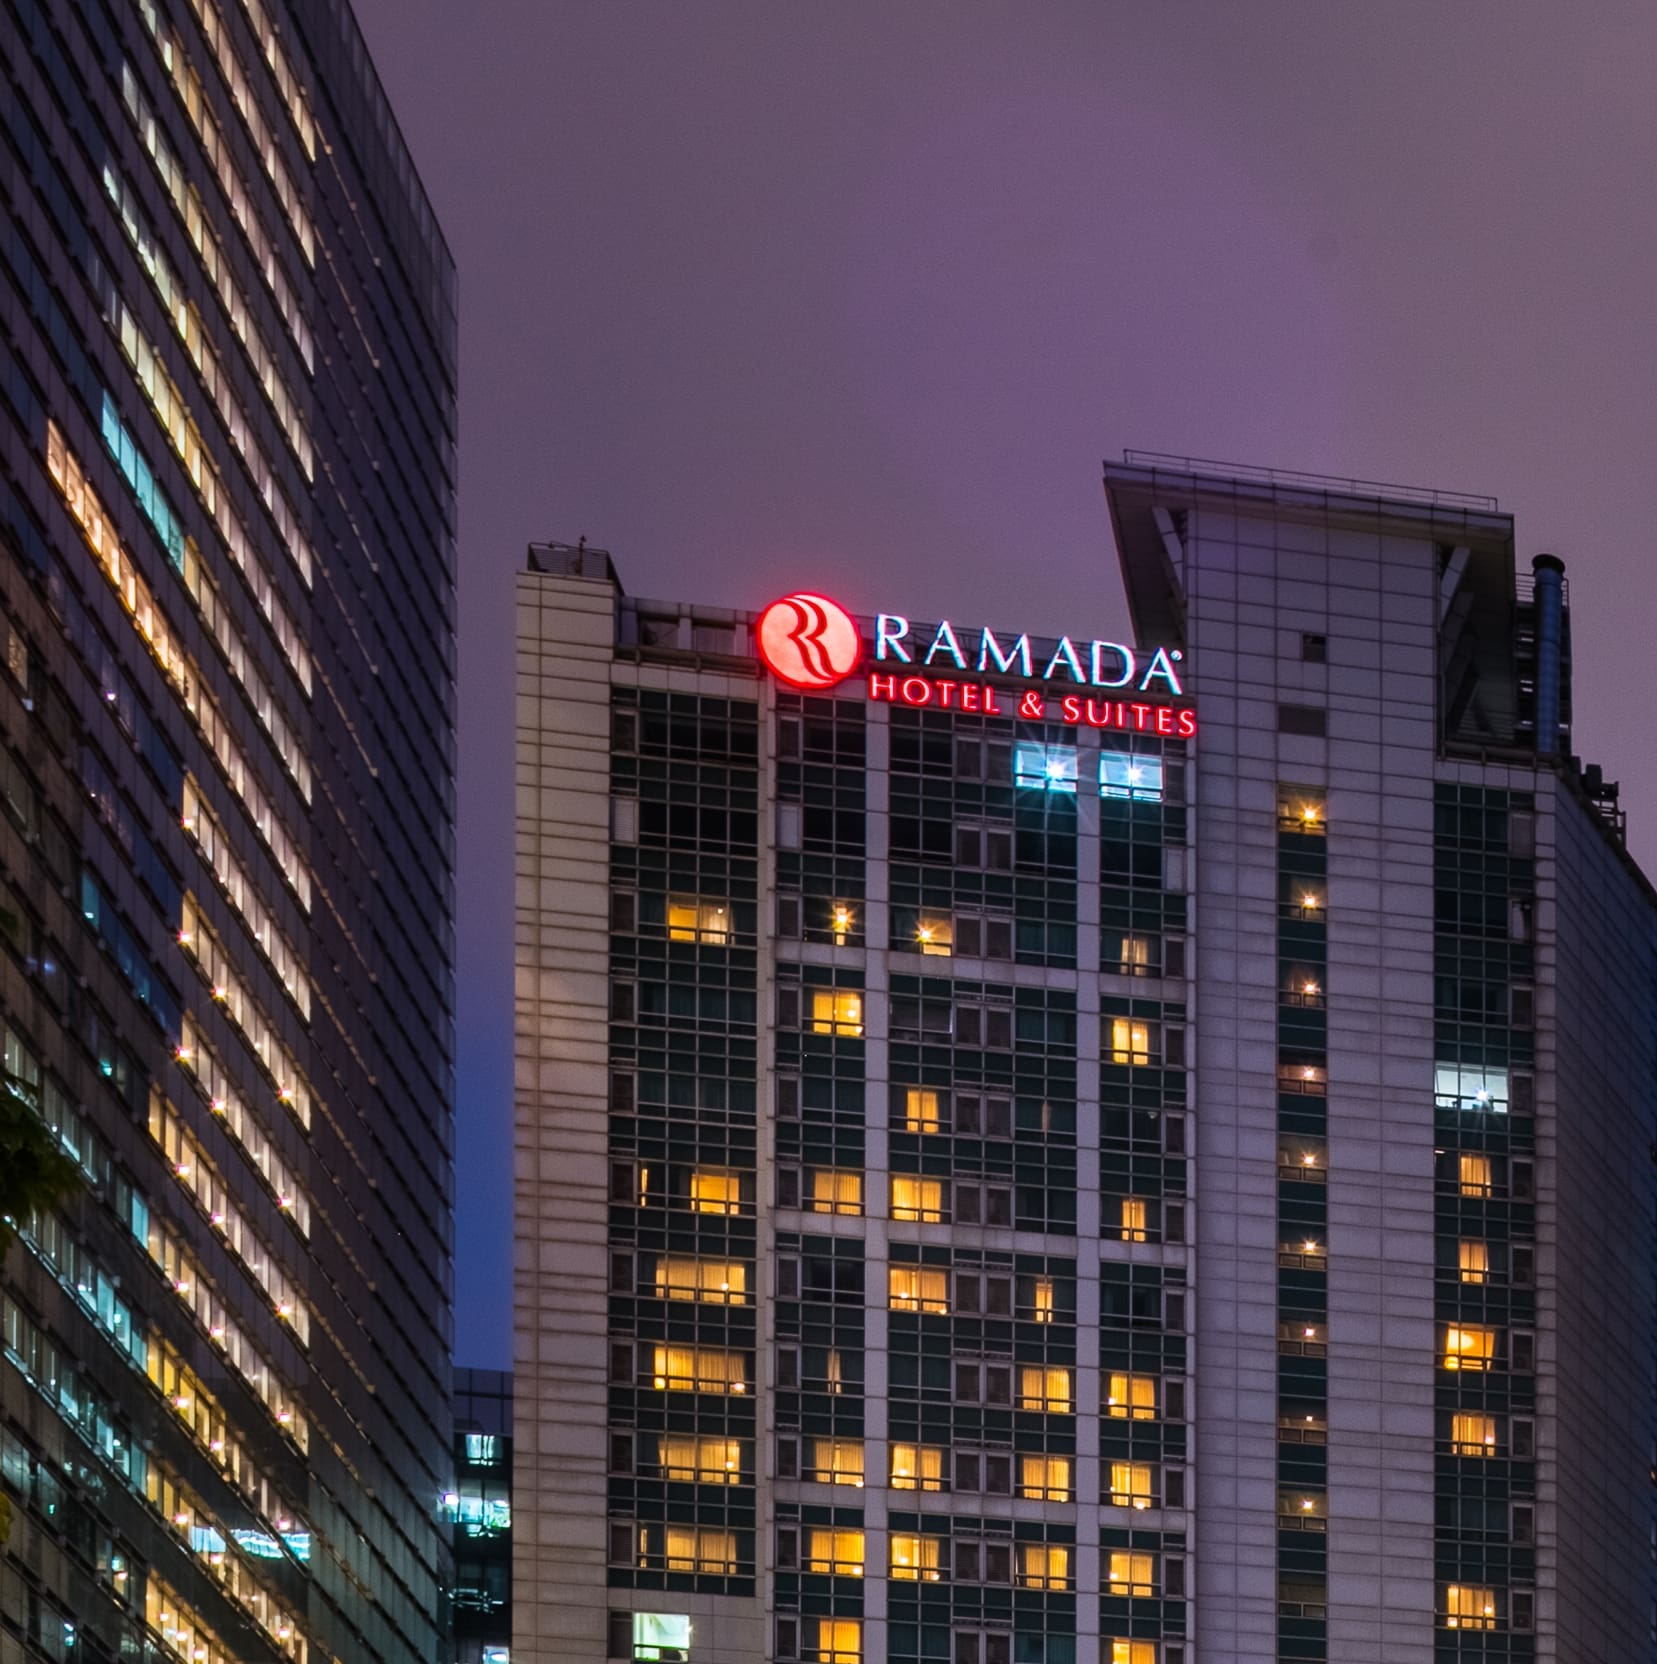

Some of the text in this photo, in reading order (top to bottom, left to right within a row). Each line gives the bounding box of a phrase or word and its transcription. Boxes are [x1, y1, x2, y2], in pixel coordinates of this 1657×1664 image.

[875, 613, 1183, 695] RAMADA
[868, 673, 1197, 737] HOTEL & SUITES
